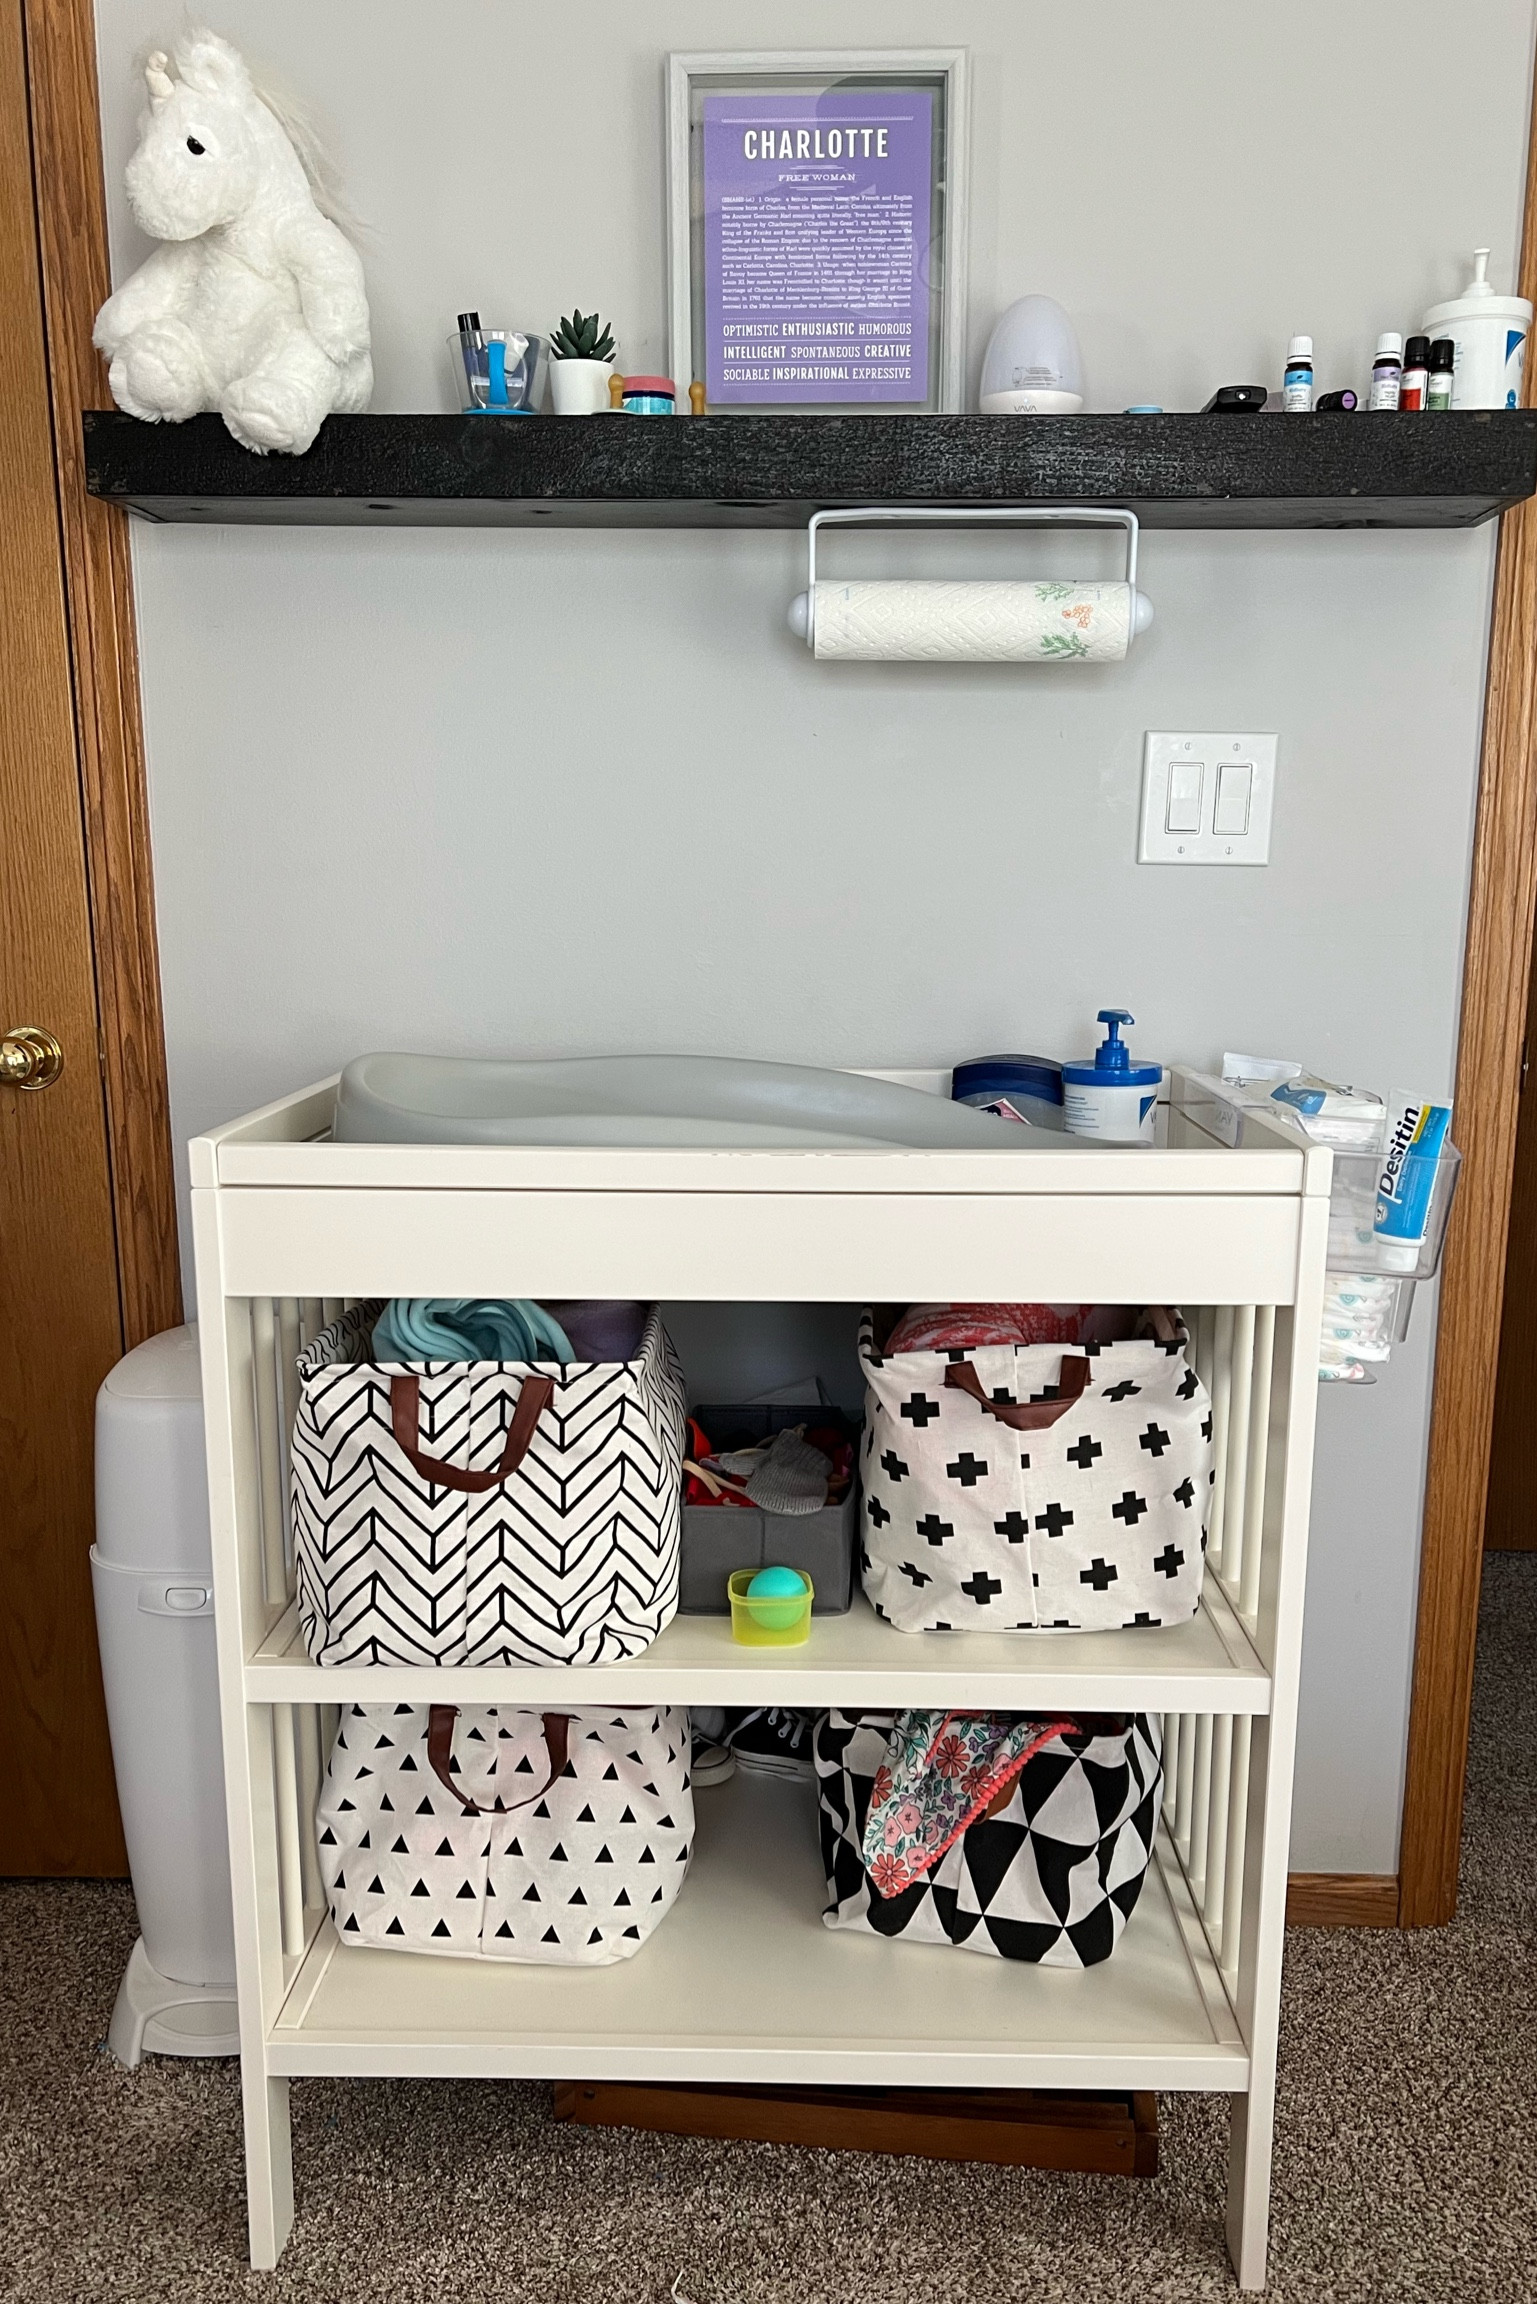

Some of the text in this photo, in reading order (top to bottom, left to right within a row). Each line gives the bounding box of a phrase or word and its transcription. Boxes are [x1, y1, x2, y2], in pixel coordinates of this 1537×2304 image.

[744, 128, 888, 160] CHARLOTTE
[778, 173, 856, 182] FREE WOMAN
[723, 322, 912, 337] OPTIMISTIC ENTHUSIASTIC HUMOROUS
[723, 344, 912, 359] INTELLIGENT SPONTANEOUS CREATIVE
[723, 366, 911, 381] SOCIABLE INSPIRATIONAL EXPRESSIVE
[1013, 404, 1038, 413] VAVA
[1380, 1107, 1420, 1197] Desitin
